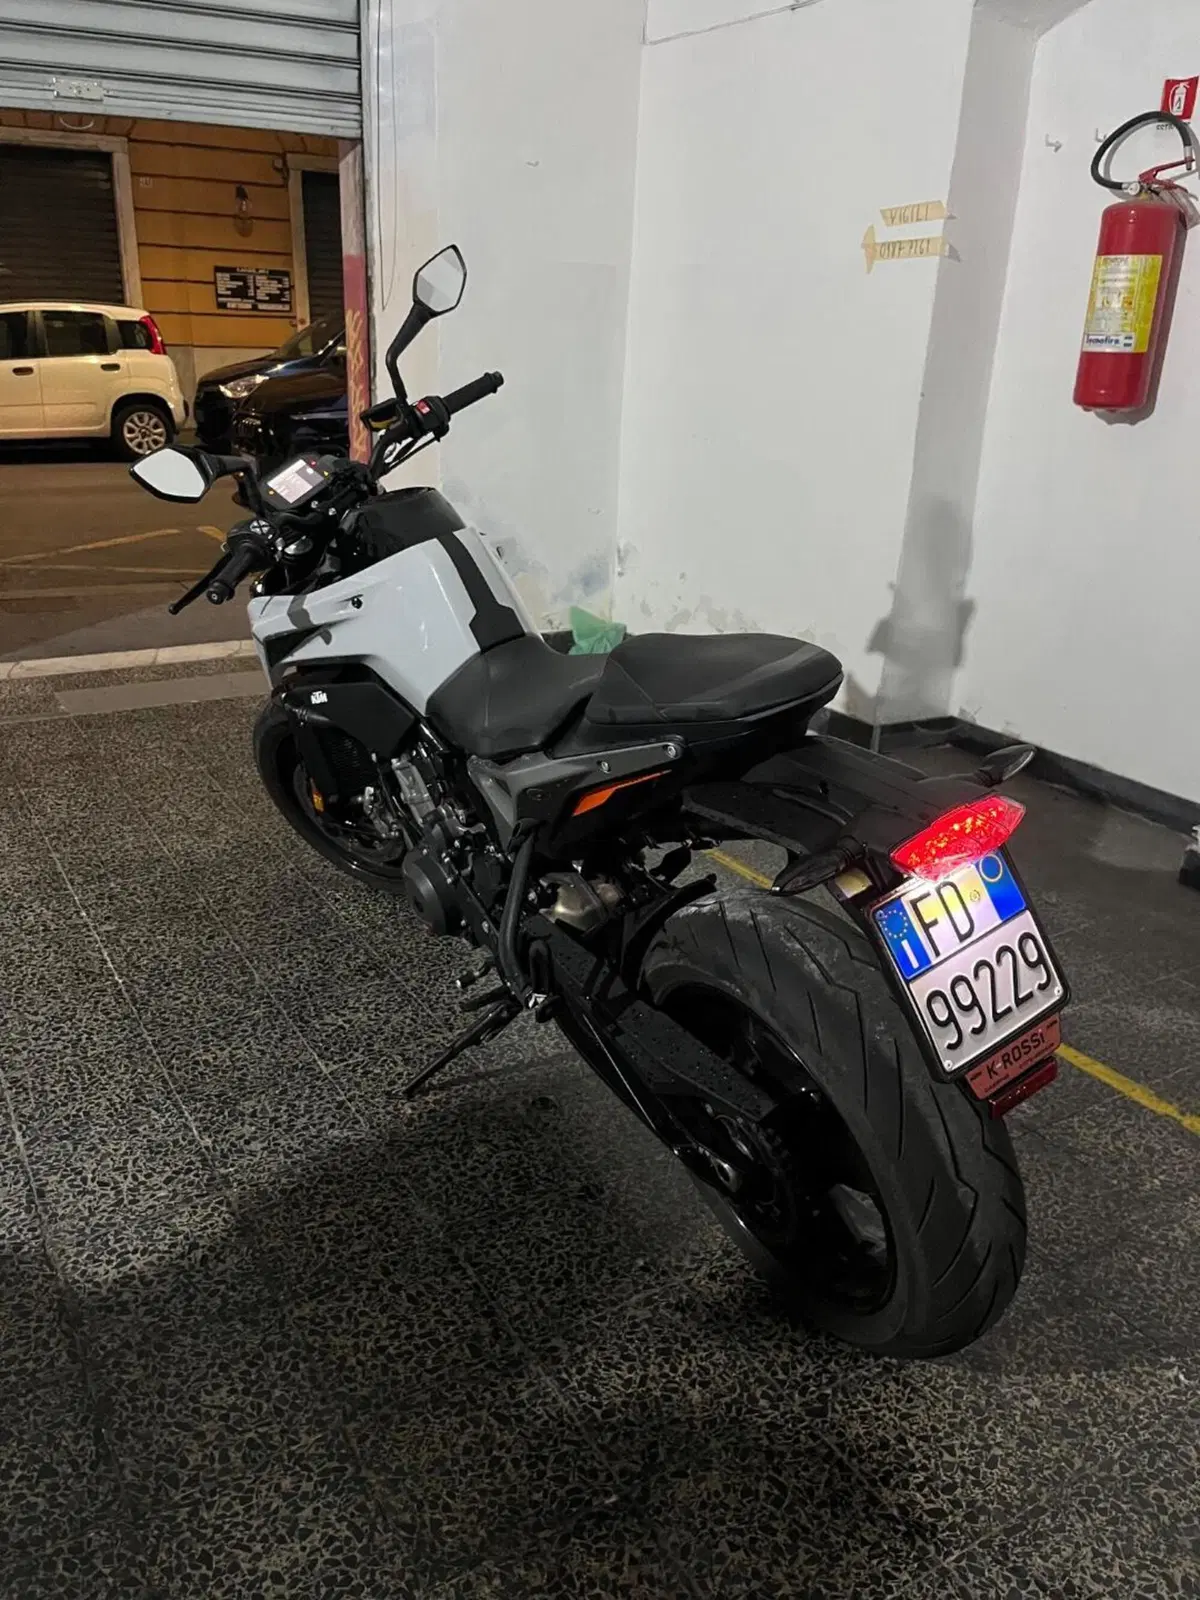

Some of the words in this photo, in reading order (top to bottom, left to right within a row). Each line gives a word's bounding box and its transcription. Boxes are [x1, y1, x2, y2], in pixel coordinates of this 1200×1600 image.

[890, 203, 929, 225] VIGILI
[310, 690, 328, 704] KTM
[909, 880, 975, 957] FD
[926, 931, 1052, 1050] 99229
